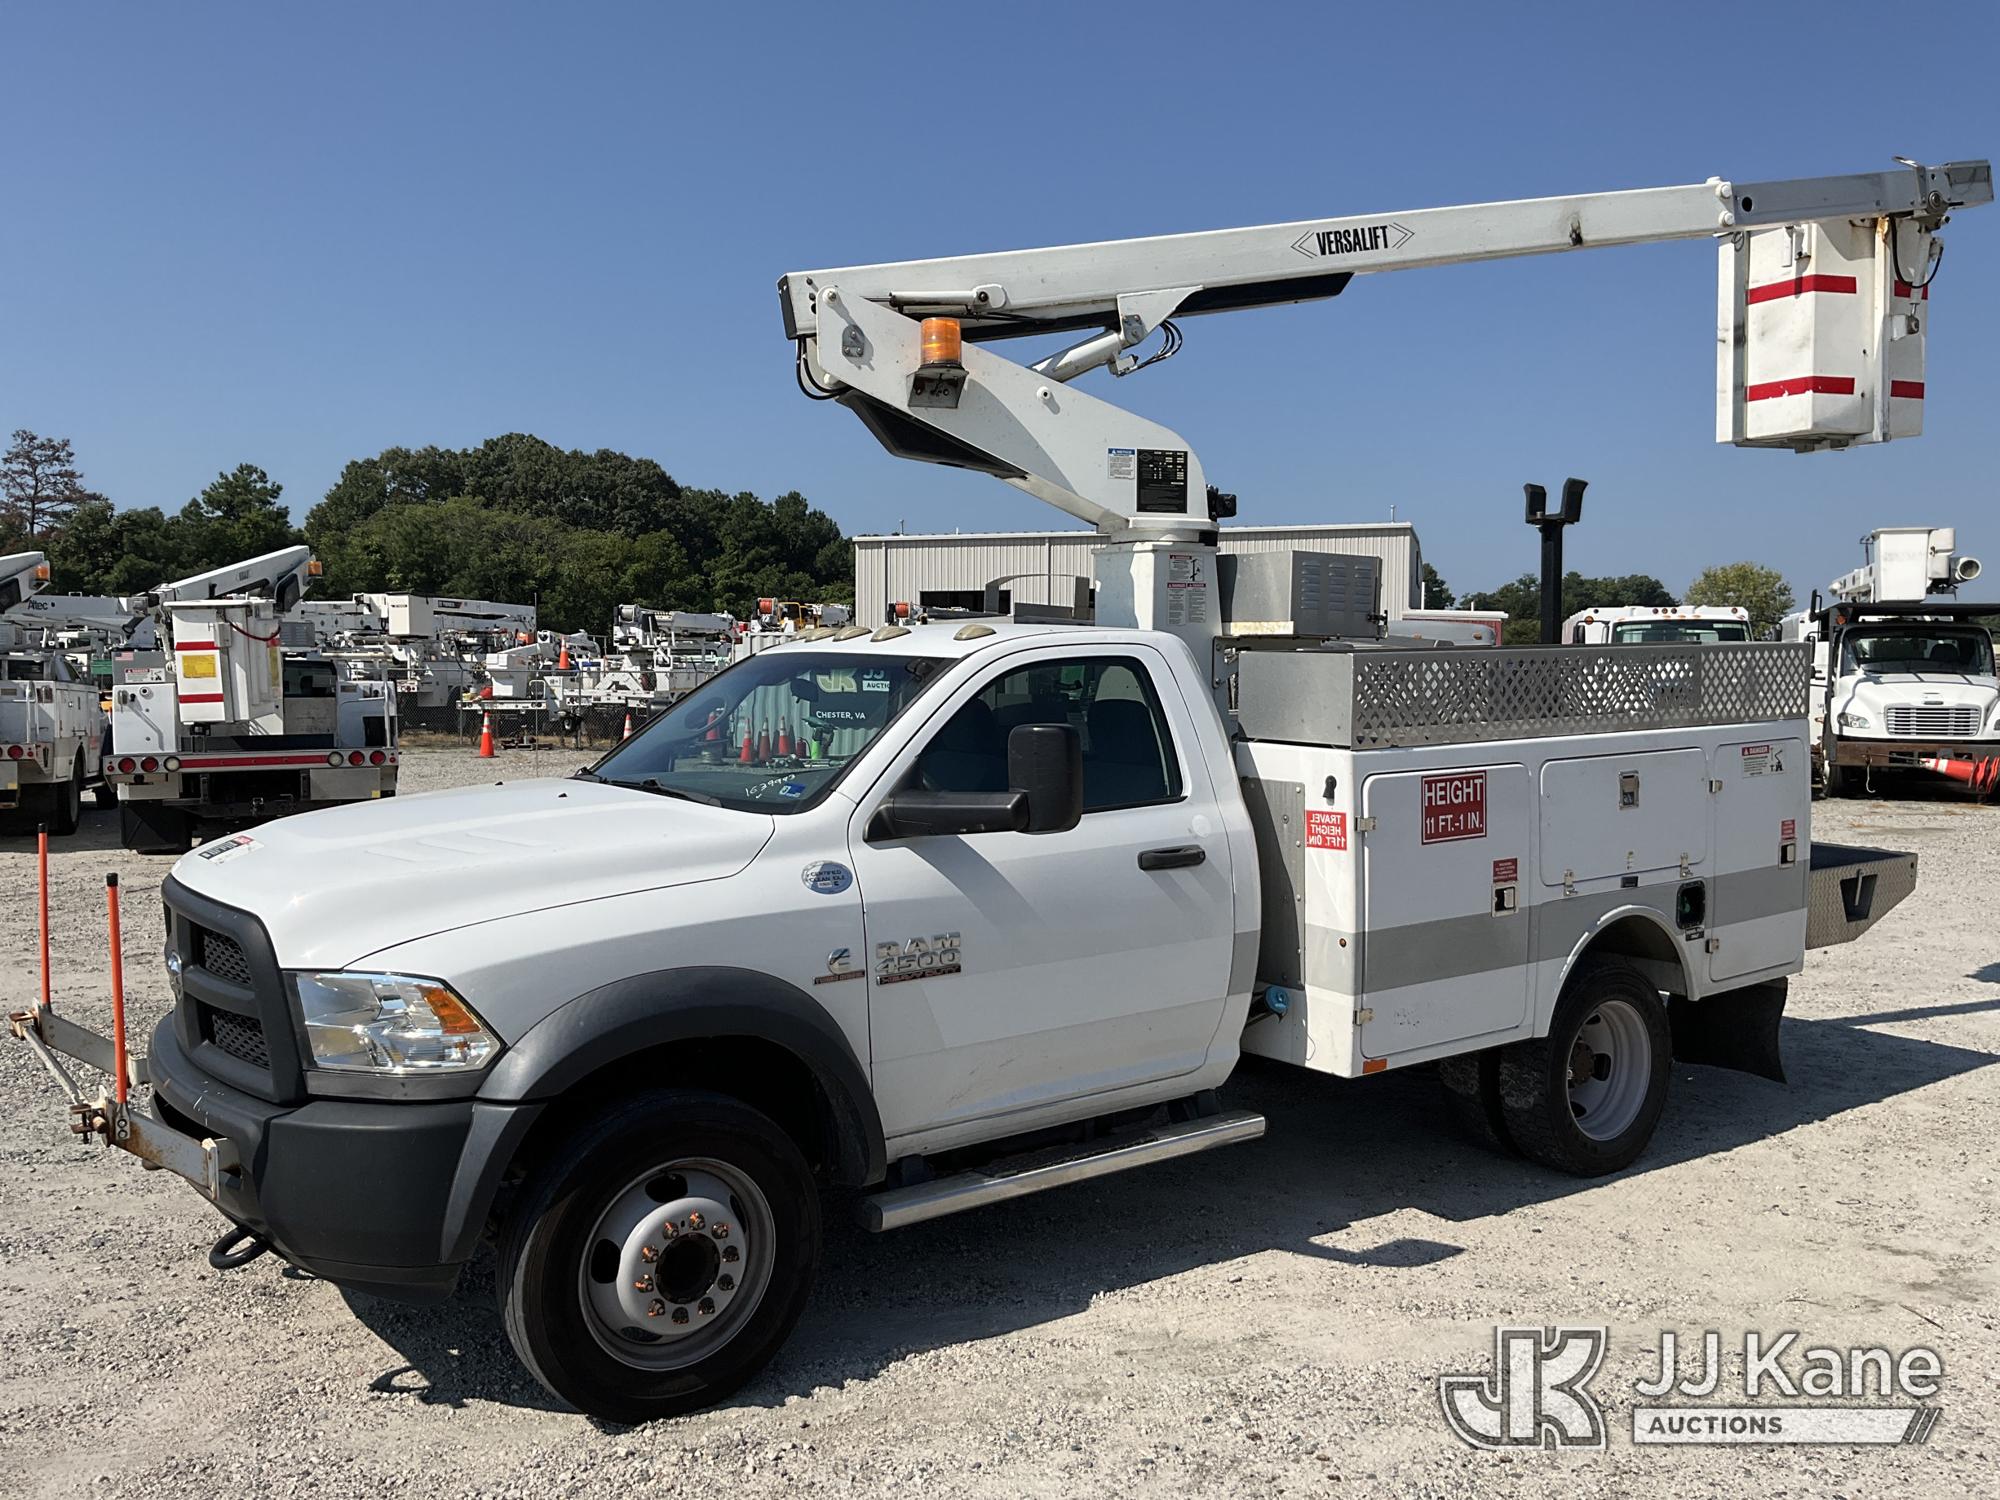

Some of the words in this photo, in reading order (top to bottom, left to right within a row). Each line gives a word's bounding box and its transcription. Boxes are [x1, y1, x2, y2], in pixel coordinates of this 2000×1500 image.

[1316, 225, 1389, 256] VERSALIFT
[815, 711, 854, 720] CHESTER,
[855, 712, 866, 720] VA
[1424, 778, 1484, 807] HEIGHT
[1426, 816, 1435, 835] 11
[1467, 811, 1483, 830] IN.
[875, 931, 961, 959] RAM
[875, 948, 962, 975] 4500
